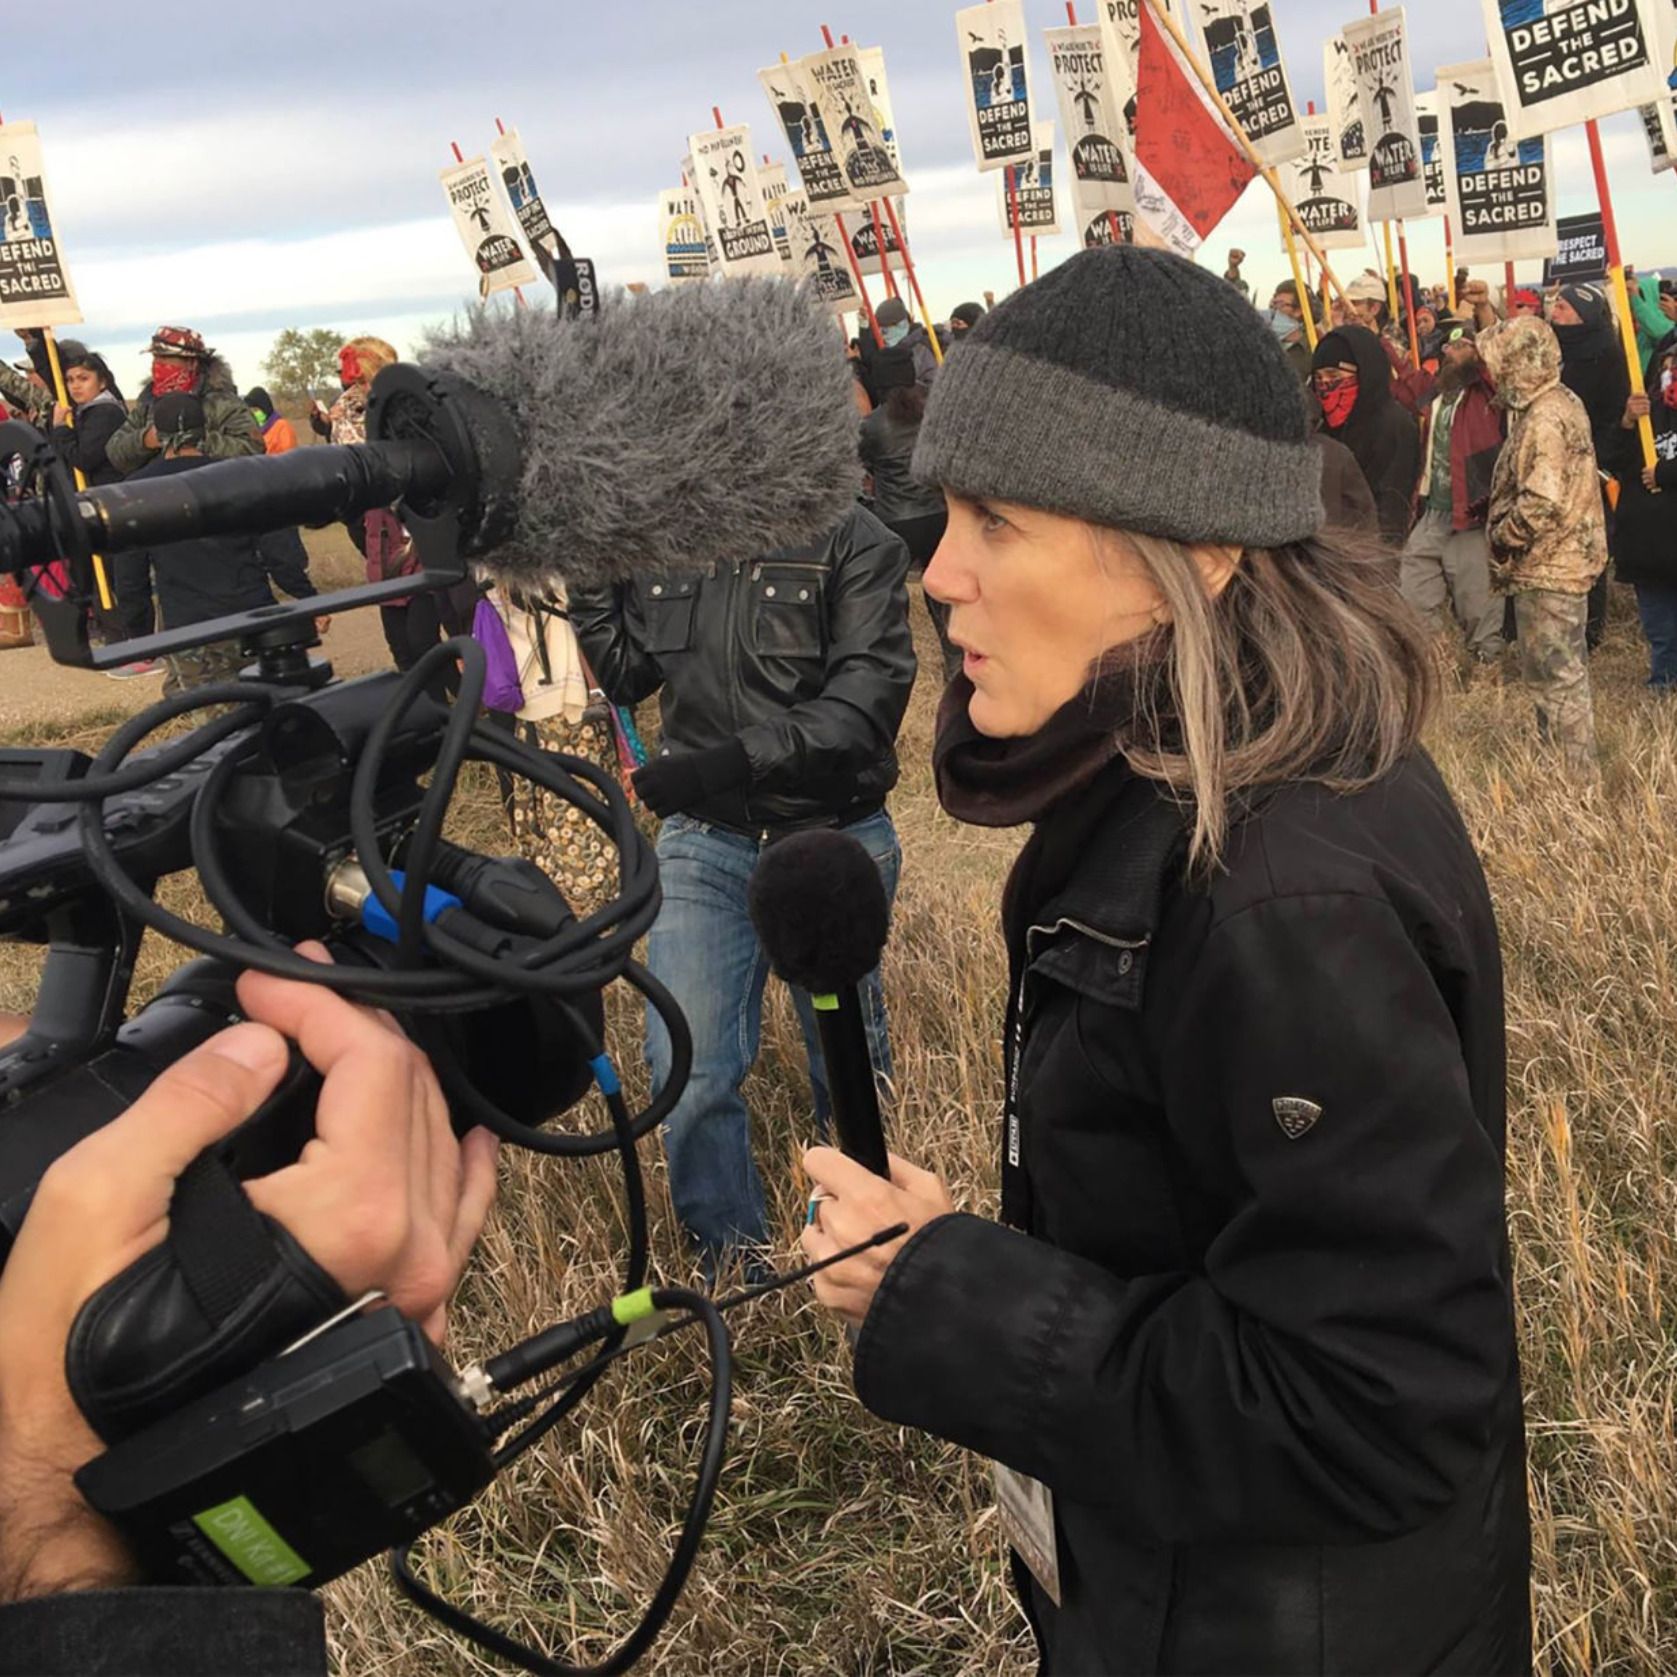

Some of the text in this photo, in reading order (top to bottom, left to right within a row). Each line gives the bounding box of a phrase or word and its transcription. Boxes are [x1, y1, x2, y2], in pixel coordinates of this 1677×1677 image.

[1511, 0, 1629, 53] DEFEND
[1558, 31, 1594, 54] THE
[1054, 53, 1103, 74] PROTECT
[1356, 38, 1402, 75] PROTECT
[1522, 36, 1639, 93] SACRED
[811, 58, 858, 85] WATER
[1221, 69, 1280, 108] DEFEND
[978, 102, 1026, 125] DEFEND
[1240, 103, 1288, 134] ACRED
[996, 121, 1012, 132] THE
[983, 131, 1028, 152] SACRED
[798, 151, 834, 170] DEFEN
[1077, 143, 1119, 164] WATER
[1374, 139, 1414, 168] WATER
[451, 176, 490, 206] PROTECT
[806, 177, 842, 196] SACRE
[1461, 167, 1541, 193] DEFEND
[1490, 192, 1514, 204] THE
[1465, 202, 1544, 227] SACRED
[857, 229, 897, 244] WAER
[1090, 213, 1133, 240] WAER
[0, 240, 53, 262] EFEND
[479, 237, 516, 260] WATER
[726, 234, 770, 258] GROUND
[1557, 234, 1598, 252] RESPECT
[1569, 246, 1605, 263] SACRED
[0, 273, 61, 295] SACRED
